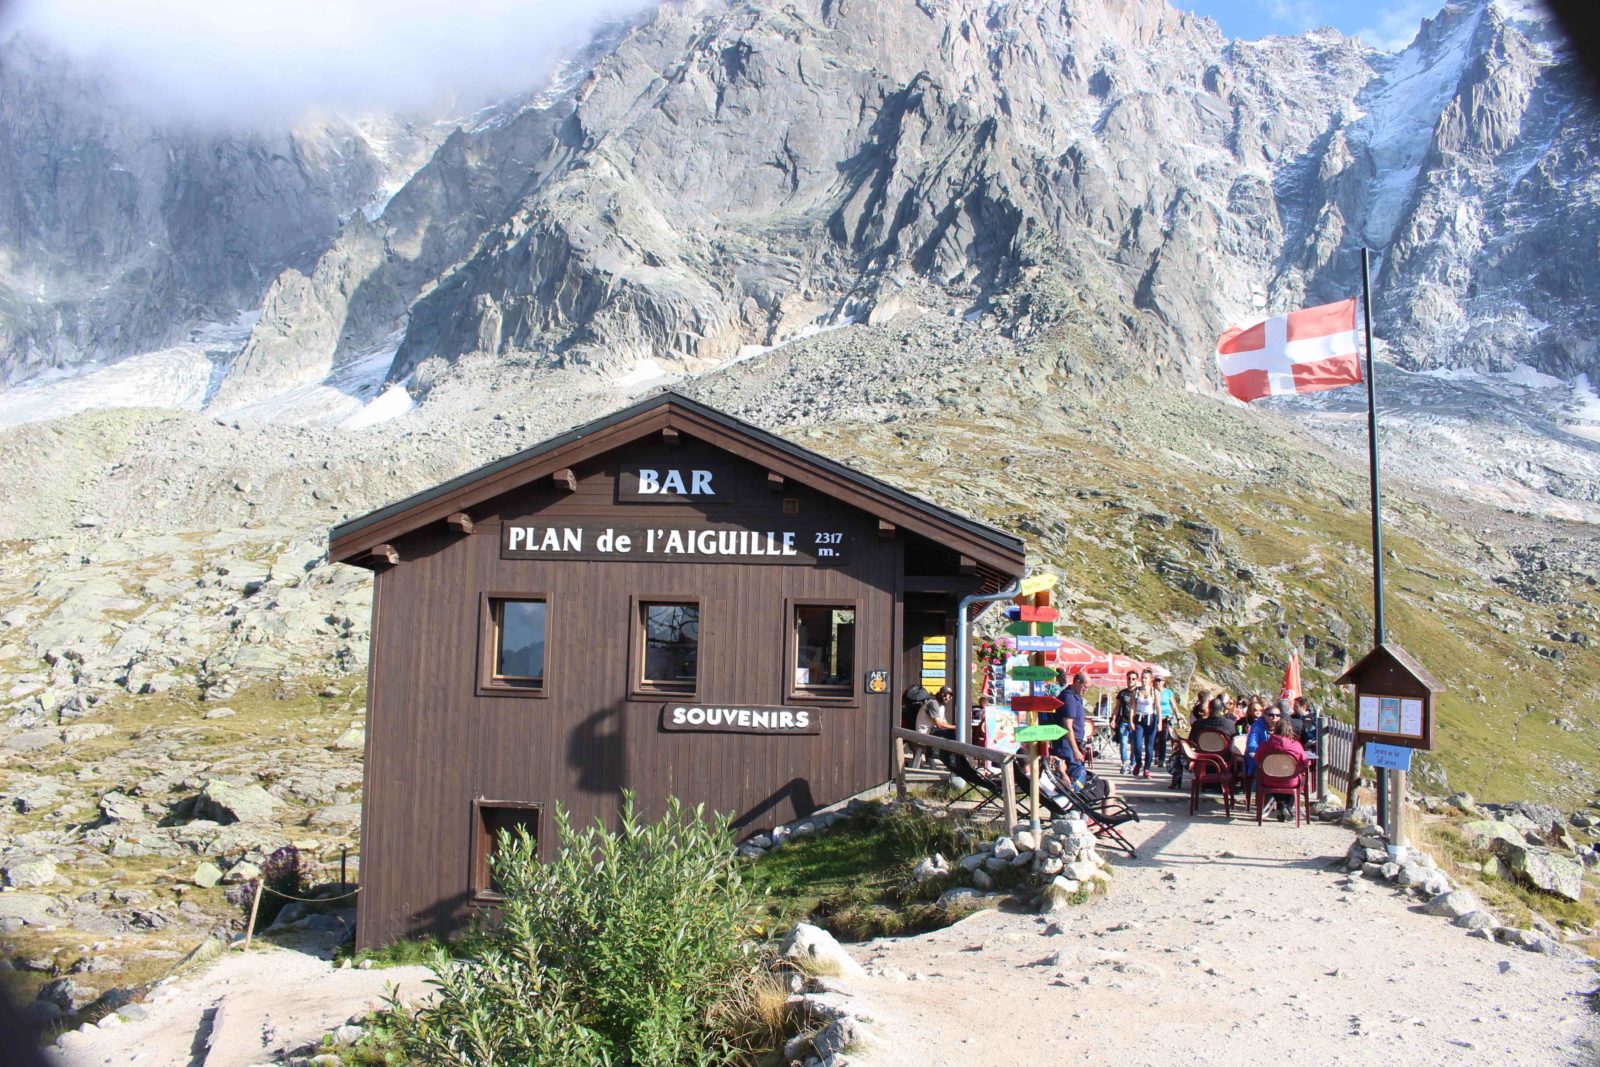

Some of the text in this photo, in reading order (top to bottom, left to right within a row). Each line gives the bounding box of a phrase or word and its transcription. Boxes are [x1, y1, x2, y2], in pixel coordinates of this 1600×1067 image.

[638, 469, 716, 495] BAR
[508, 527, 798, 555] PLAN de l'AIGUILLE
[814, 532, 844, 544] 2317
[818, 547, 841, 557] m.
[871, 671, 888, 679] ART
[672, 707, 810, 729] SOUVENIRS
